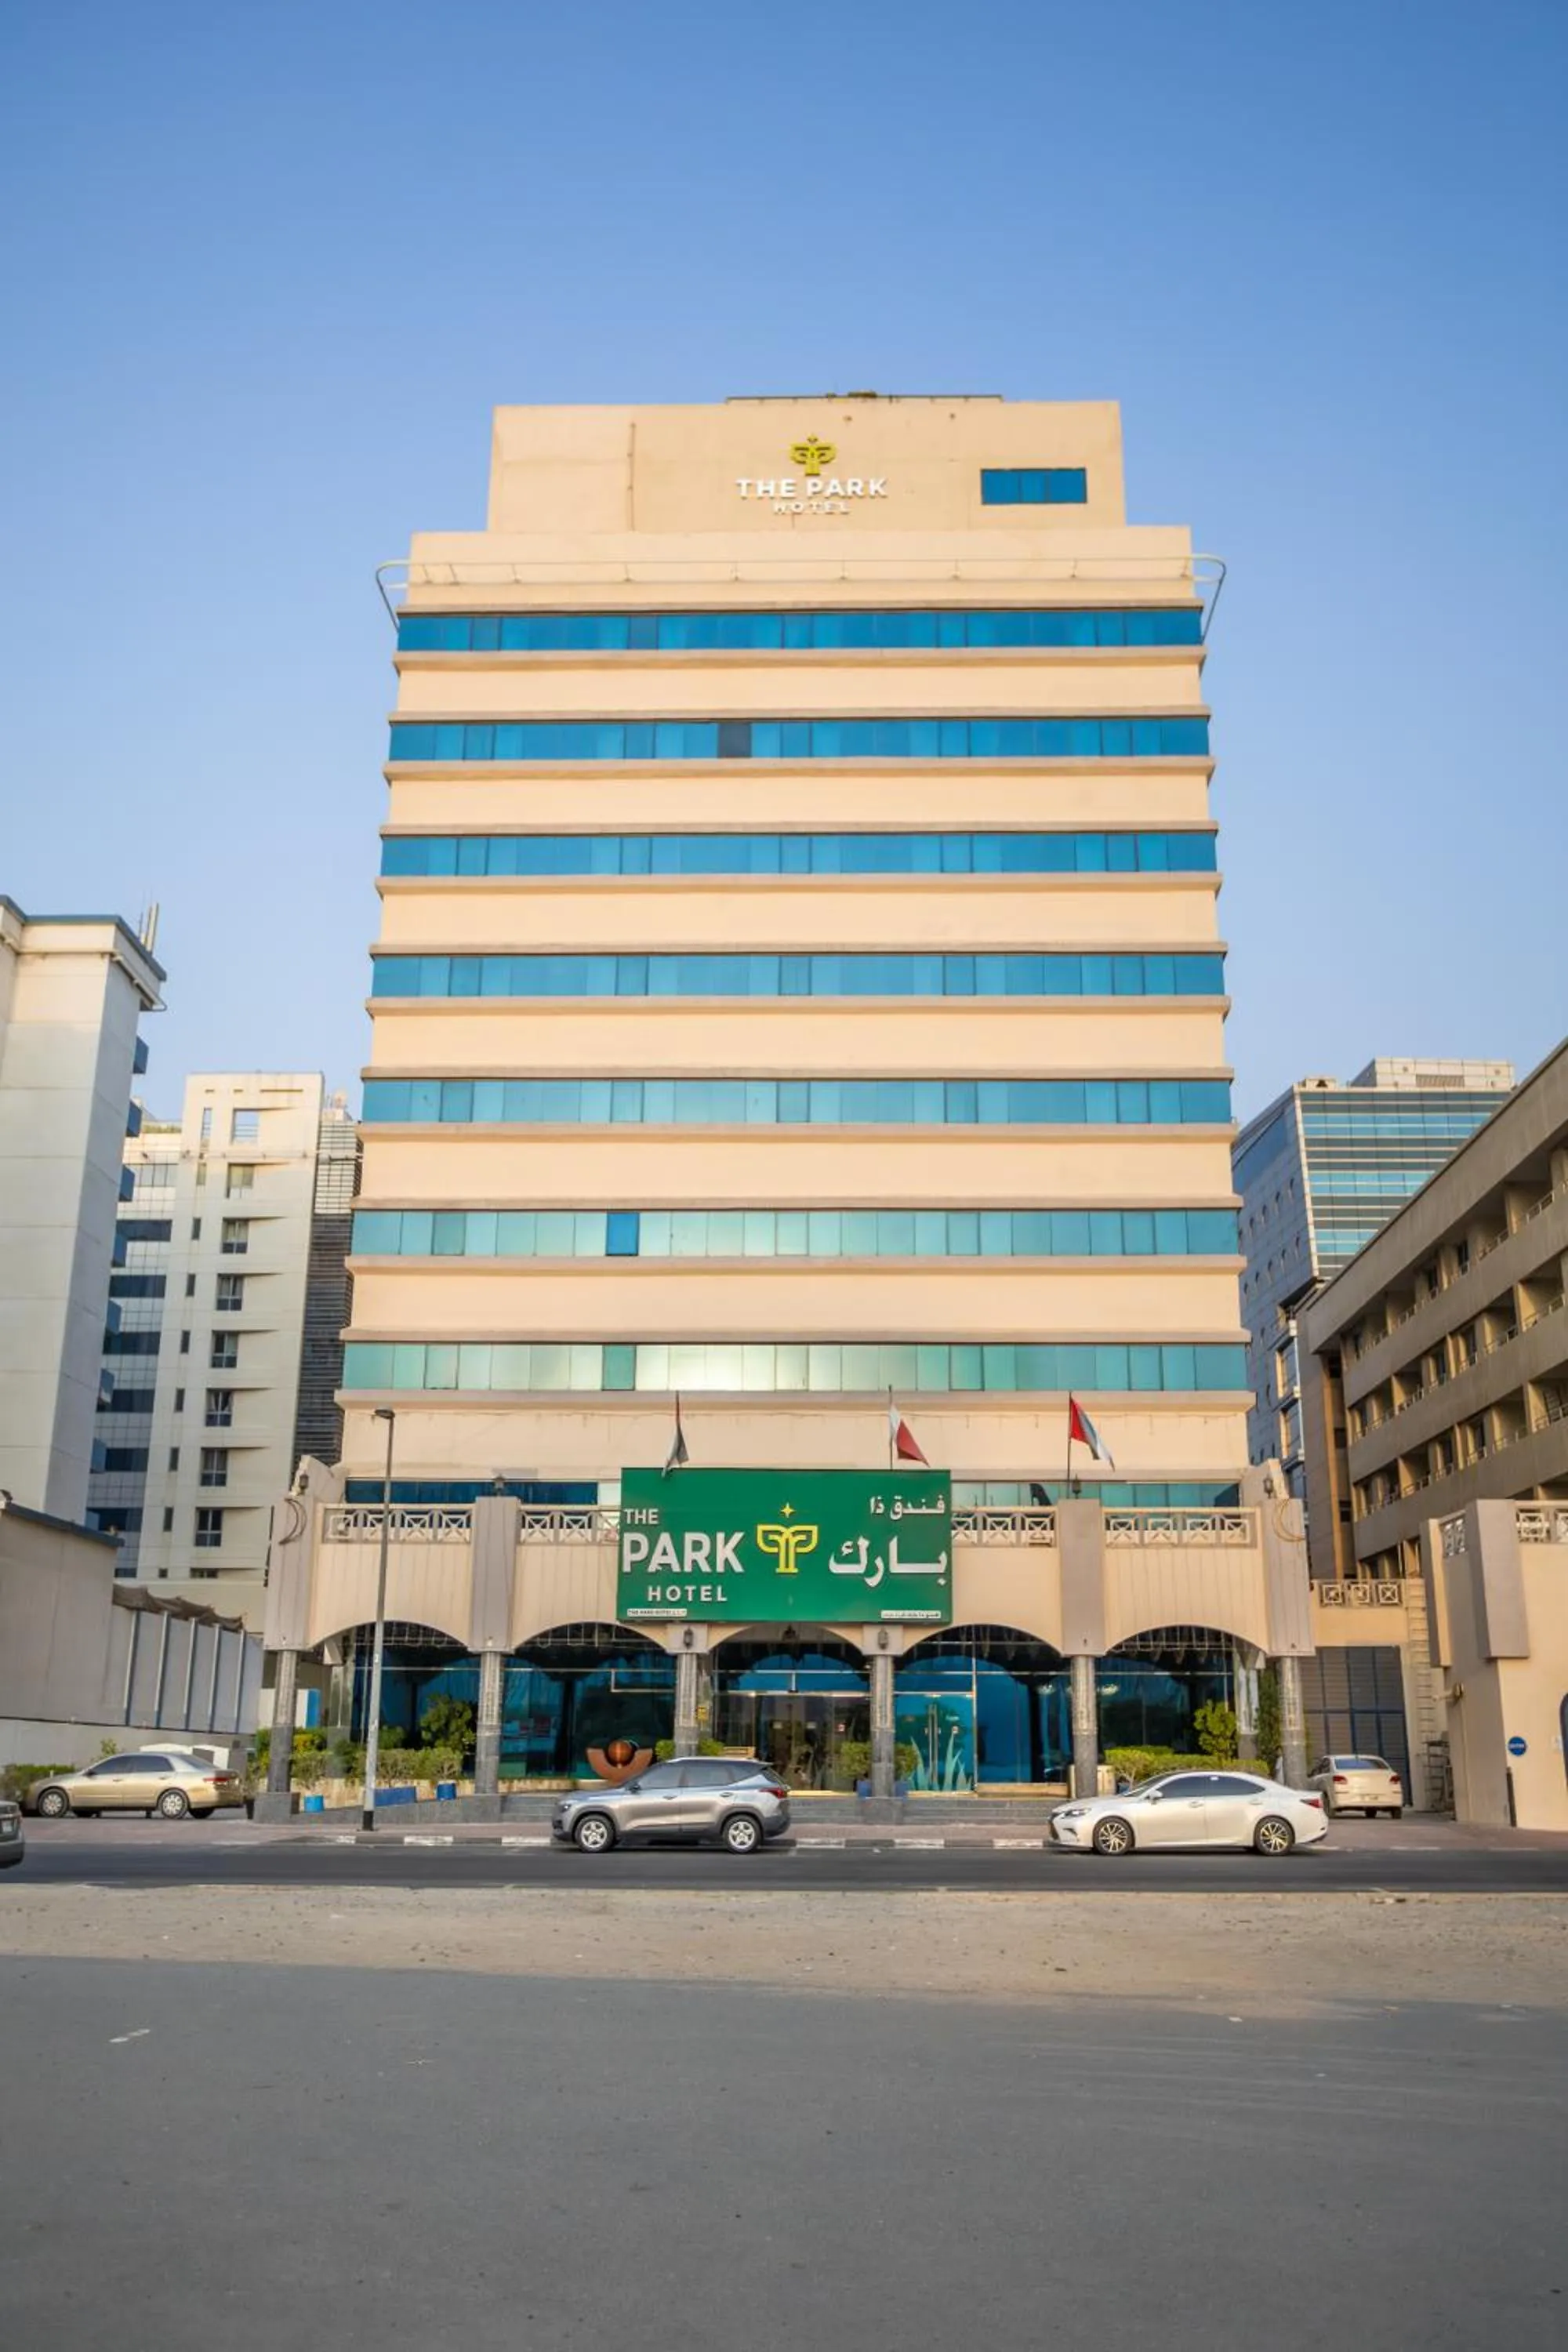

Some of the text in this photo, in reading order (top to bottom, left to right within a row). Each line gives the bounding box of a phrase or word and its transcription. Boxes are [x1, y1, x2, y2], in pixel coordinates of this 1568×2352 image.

[736, 477, 887, 498] THE PARK
[774, 501, 850, 514] HOTEL
[624, 1508, 659, 1525] THE
[869, 1494, 945, 1520] فندق ذا
[622, 1531, 745, 1573] PARK
[828, 1535, 948, 1588] بارك
[647, 1585, 728, 1602] HOTEL
